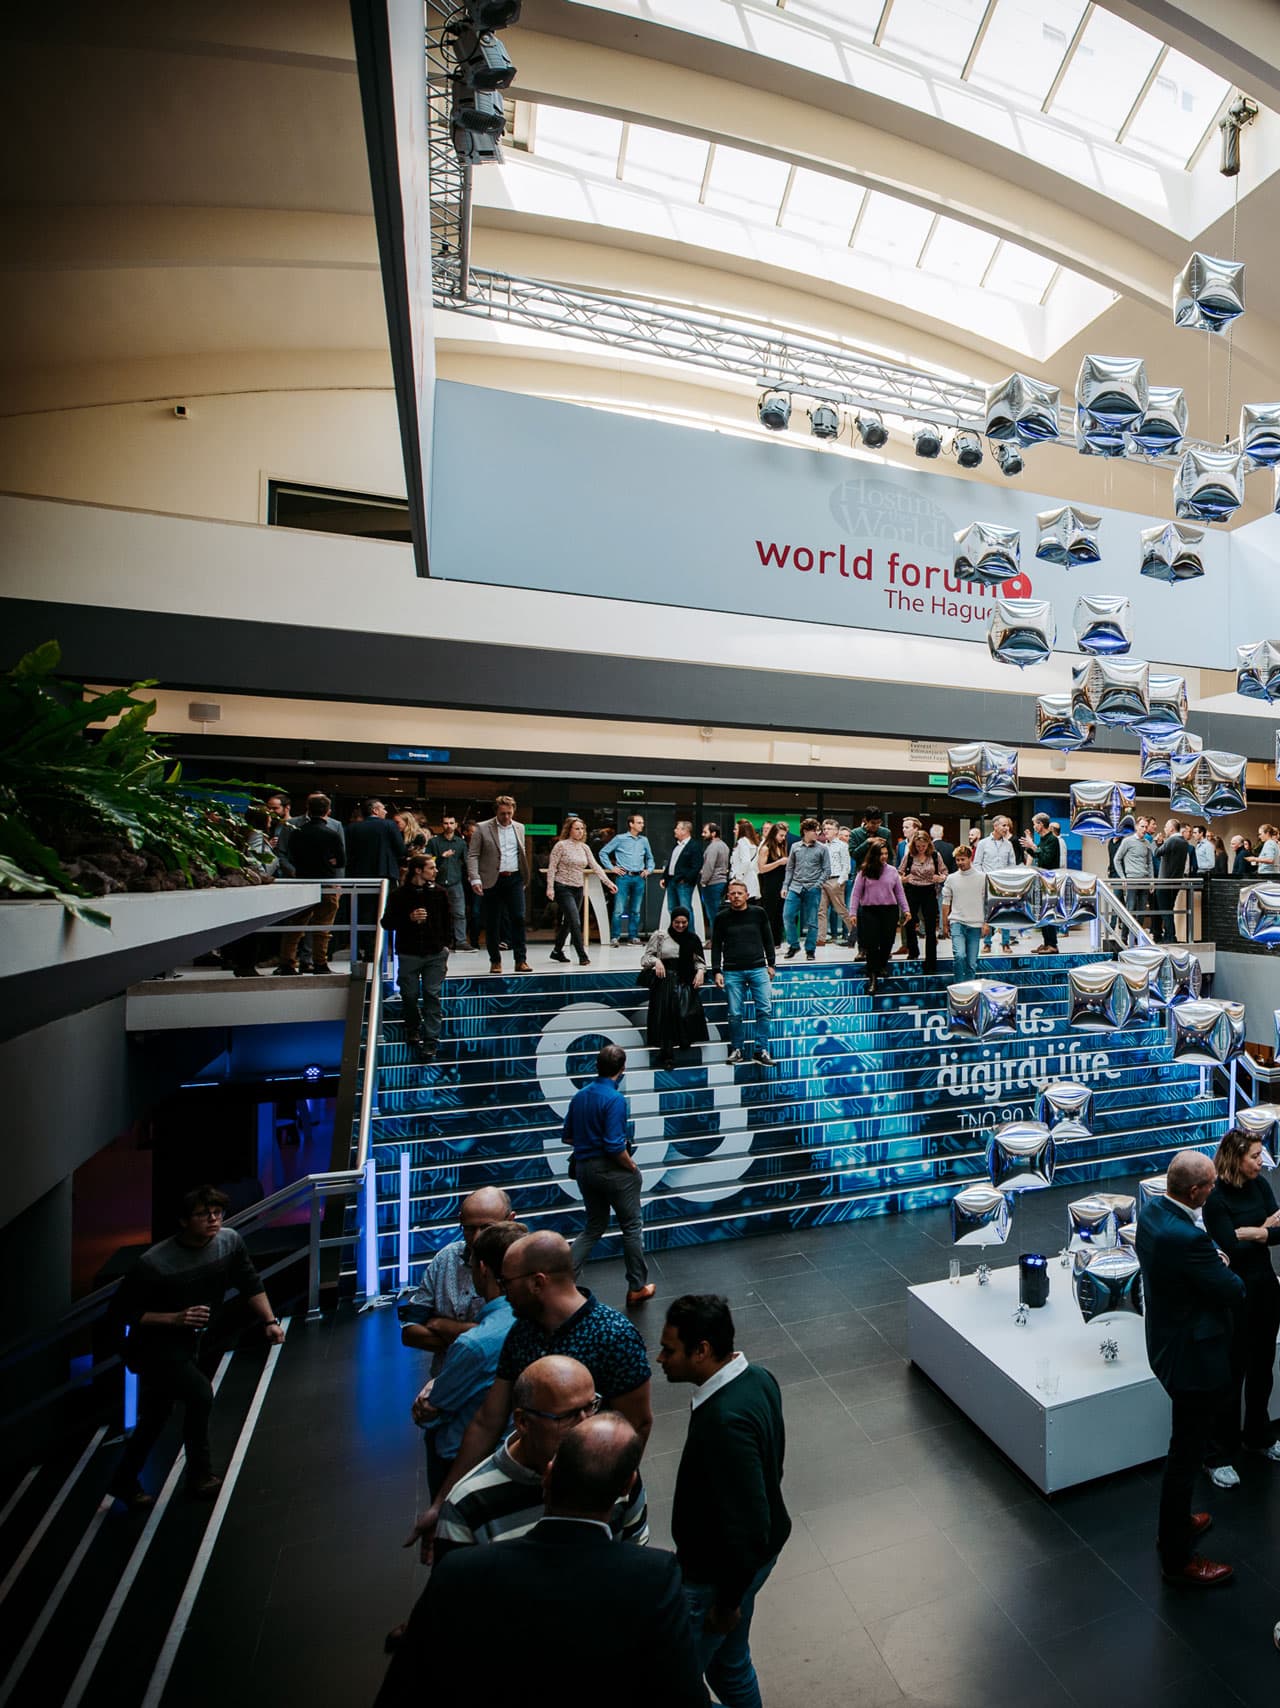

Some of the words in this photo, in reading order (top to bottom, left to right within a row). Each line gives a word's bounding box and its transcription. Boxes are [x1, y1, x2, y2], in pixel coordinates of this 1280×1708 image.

[840, 477, 944, 518] Hosting
[755, 540, 873, 581] world
[883, 588, 925, 613] The
[898, 1003, 1055, 1042] Tods
[937, 1046, 1056, 1104] digital
[1047, 1041, 1122, 1083] life
[956, 1110, 997, 1138] TNO
